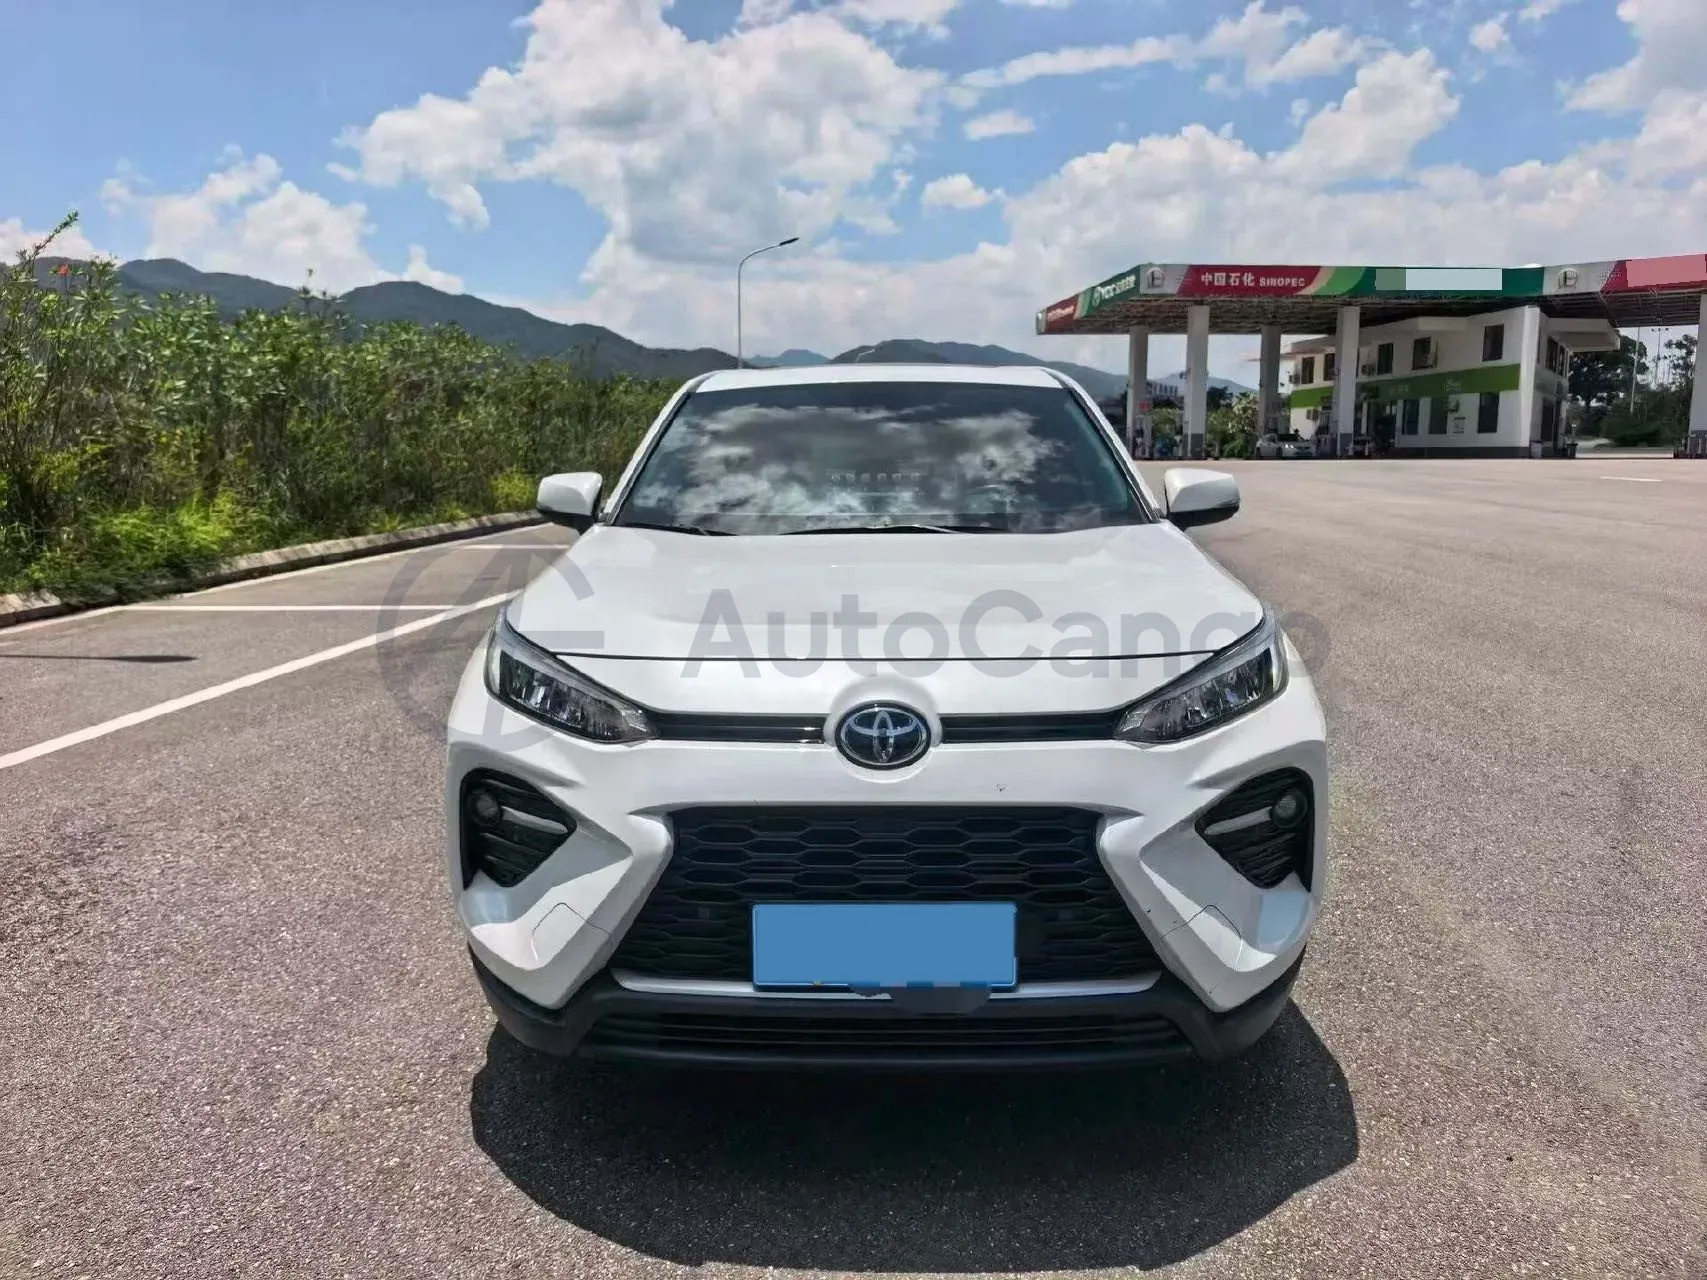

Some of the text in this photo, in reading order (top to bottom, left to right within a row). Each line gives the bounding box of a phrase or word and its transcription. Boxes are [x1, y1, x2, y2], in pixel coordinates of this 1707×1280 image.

[1201, 272, 1255, 287] 中国石化
[1259, 277, 1305, 287] SINOPEC
